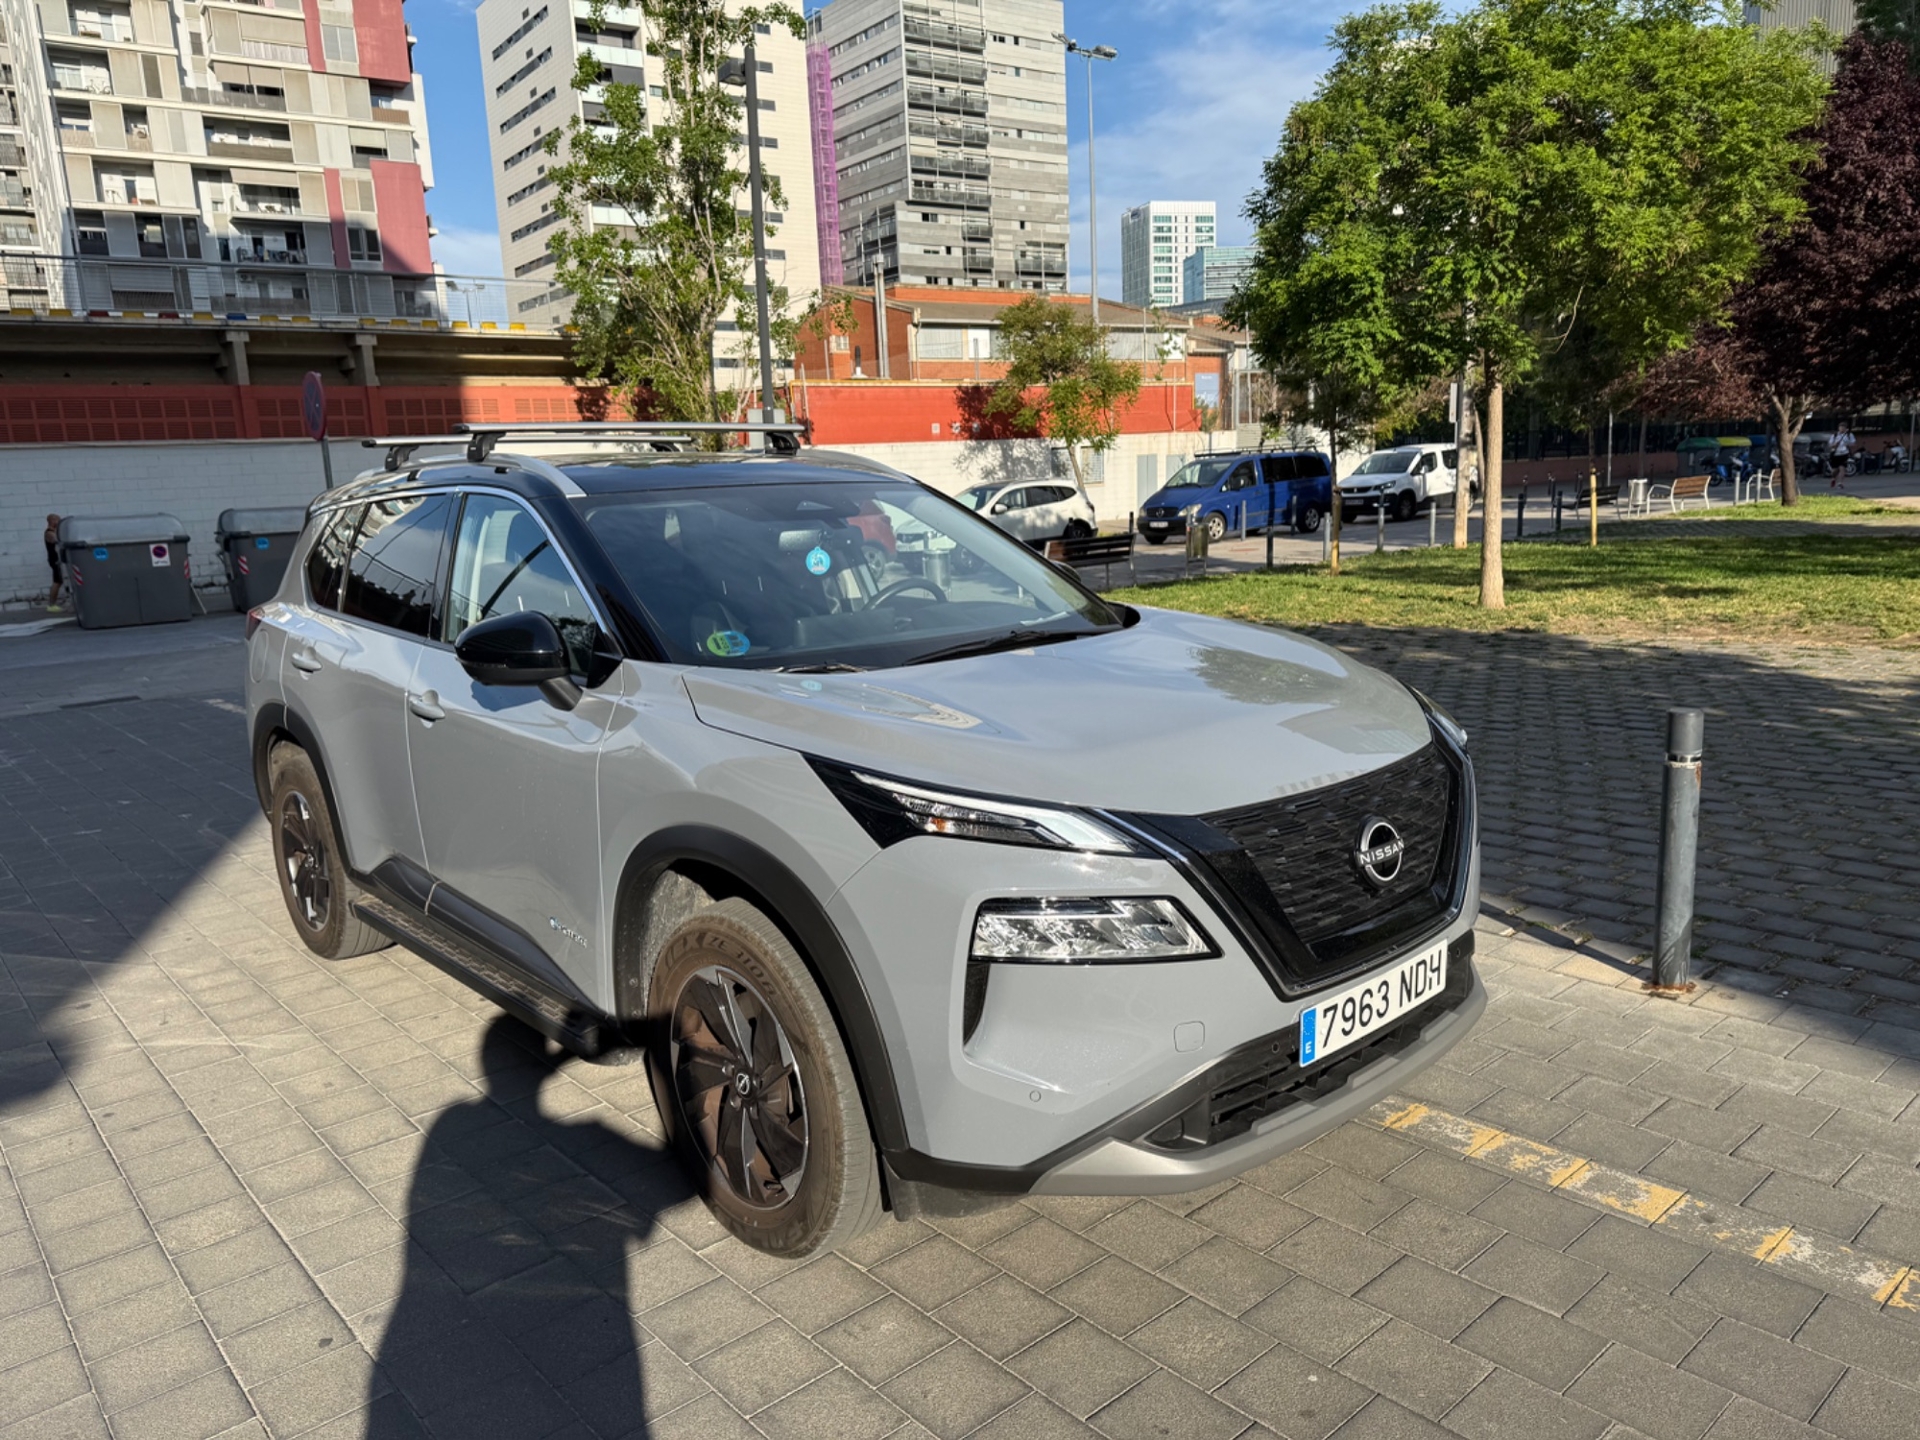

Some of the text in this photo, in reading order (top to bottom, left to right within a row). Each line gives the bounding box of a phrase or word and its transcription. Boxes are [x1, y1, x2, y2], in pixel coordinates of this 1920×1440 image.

[1359, 838, 1405, 864] NISSAN
[1305, 949, 1443, 1055] E 7963 NDH
